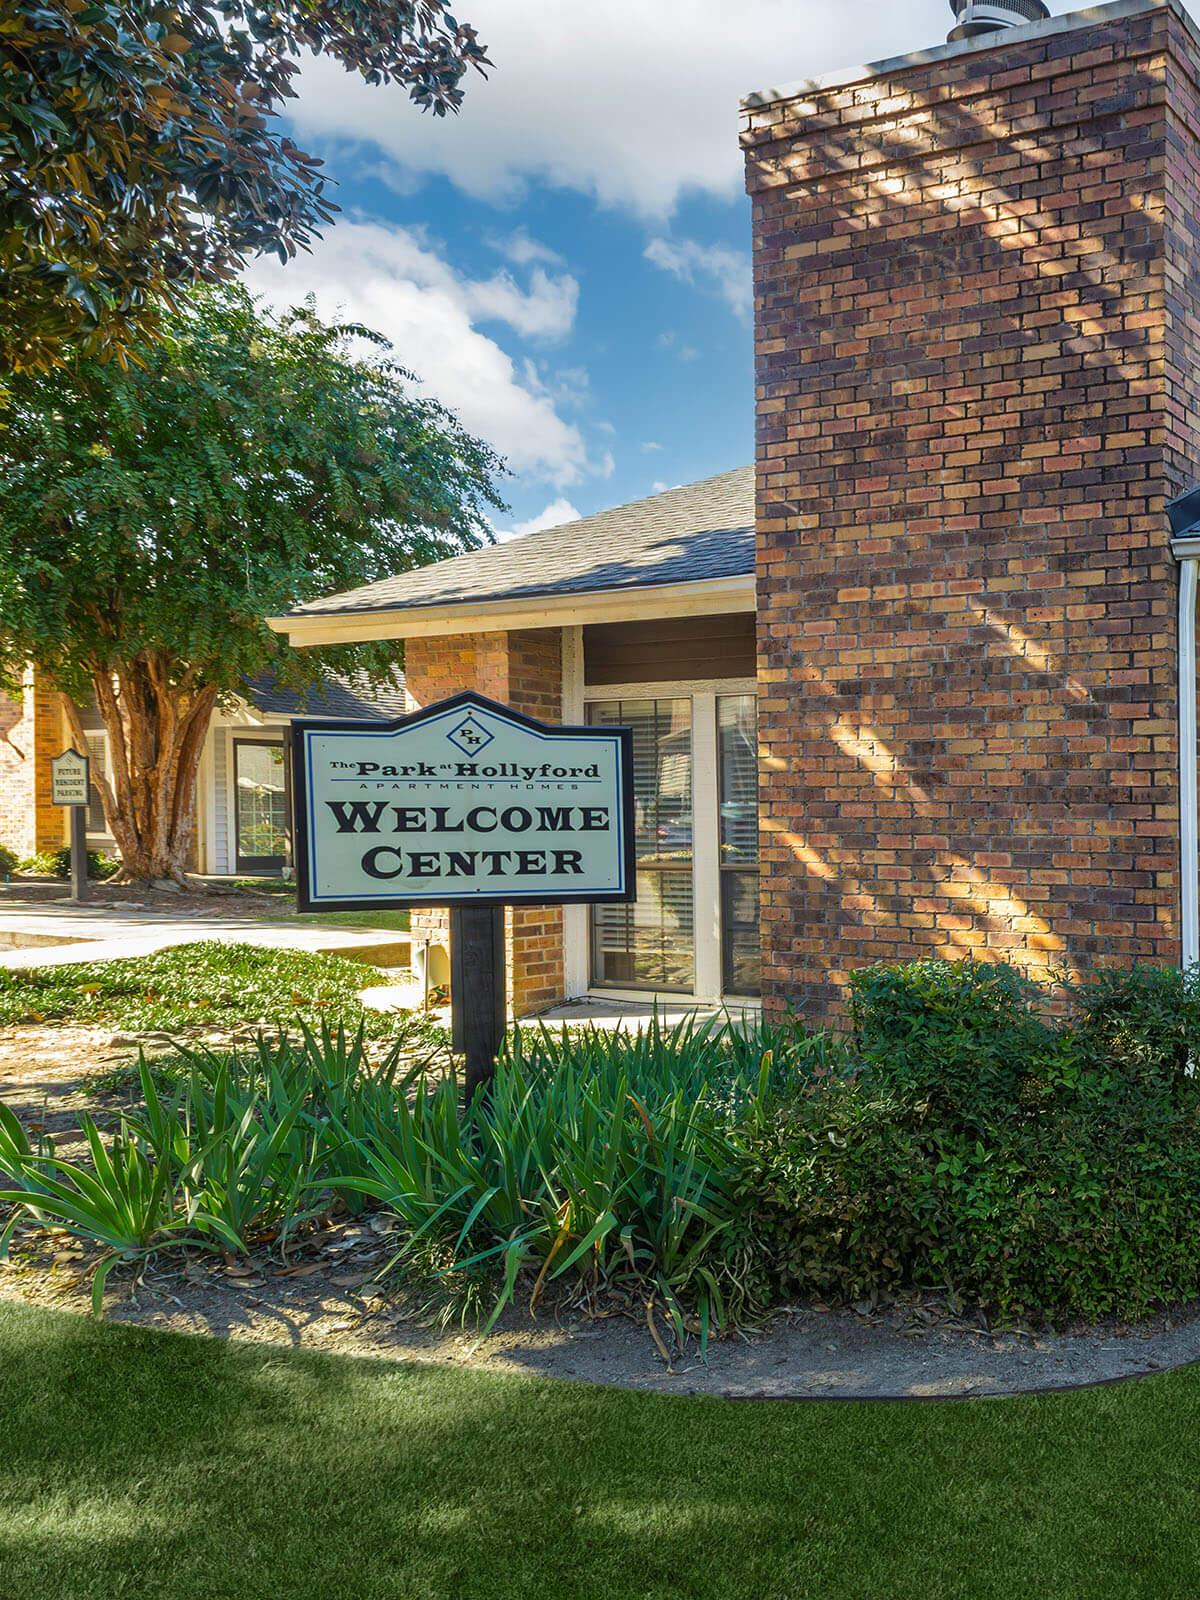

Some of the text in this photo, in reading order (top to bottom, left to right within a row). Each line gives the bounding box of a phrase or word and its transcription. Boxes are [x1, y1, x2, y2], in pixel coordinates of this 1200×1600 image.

[330, 761, 357, 769] The
[356, 762, 438, 777] Park
[454, 763, 602, 781] Hollyford
[325, 801, 610, 833] WELCOME
[361, 846, 585, 879] CENTER
